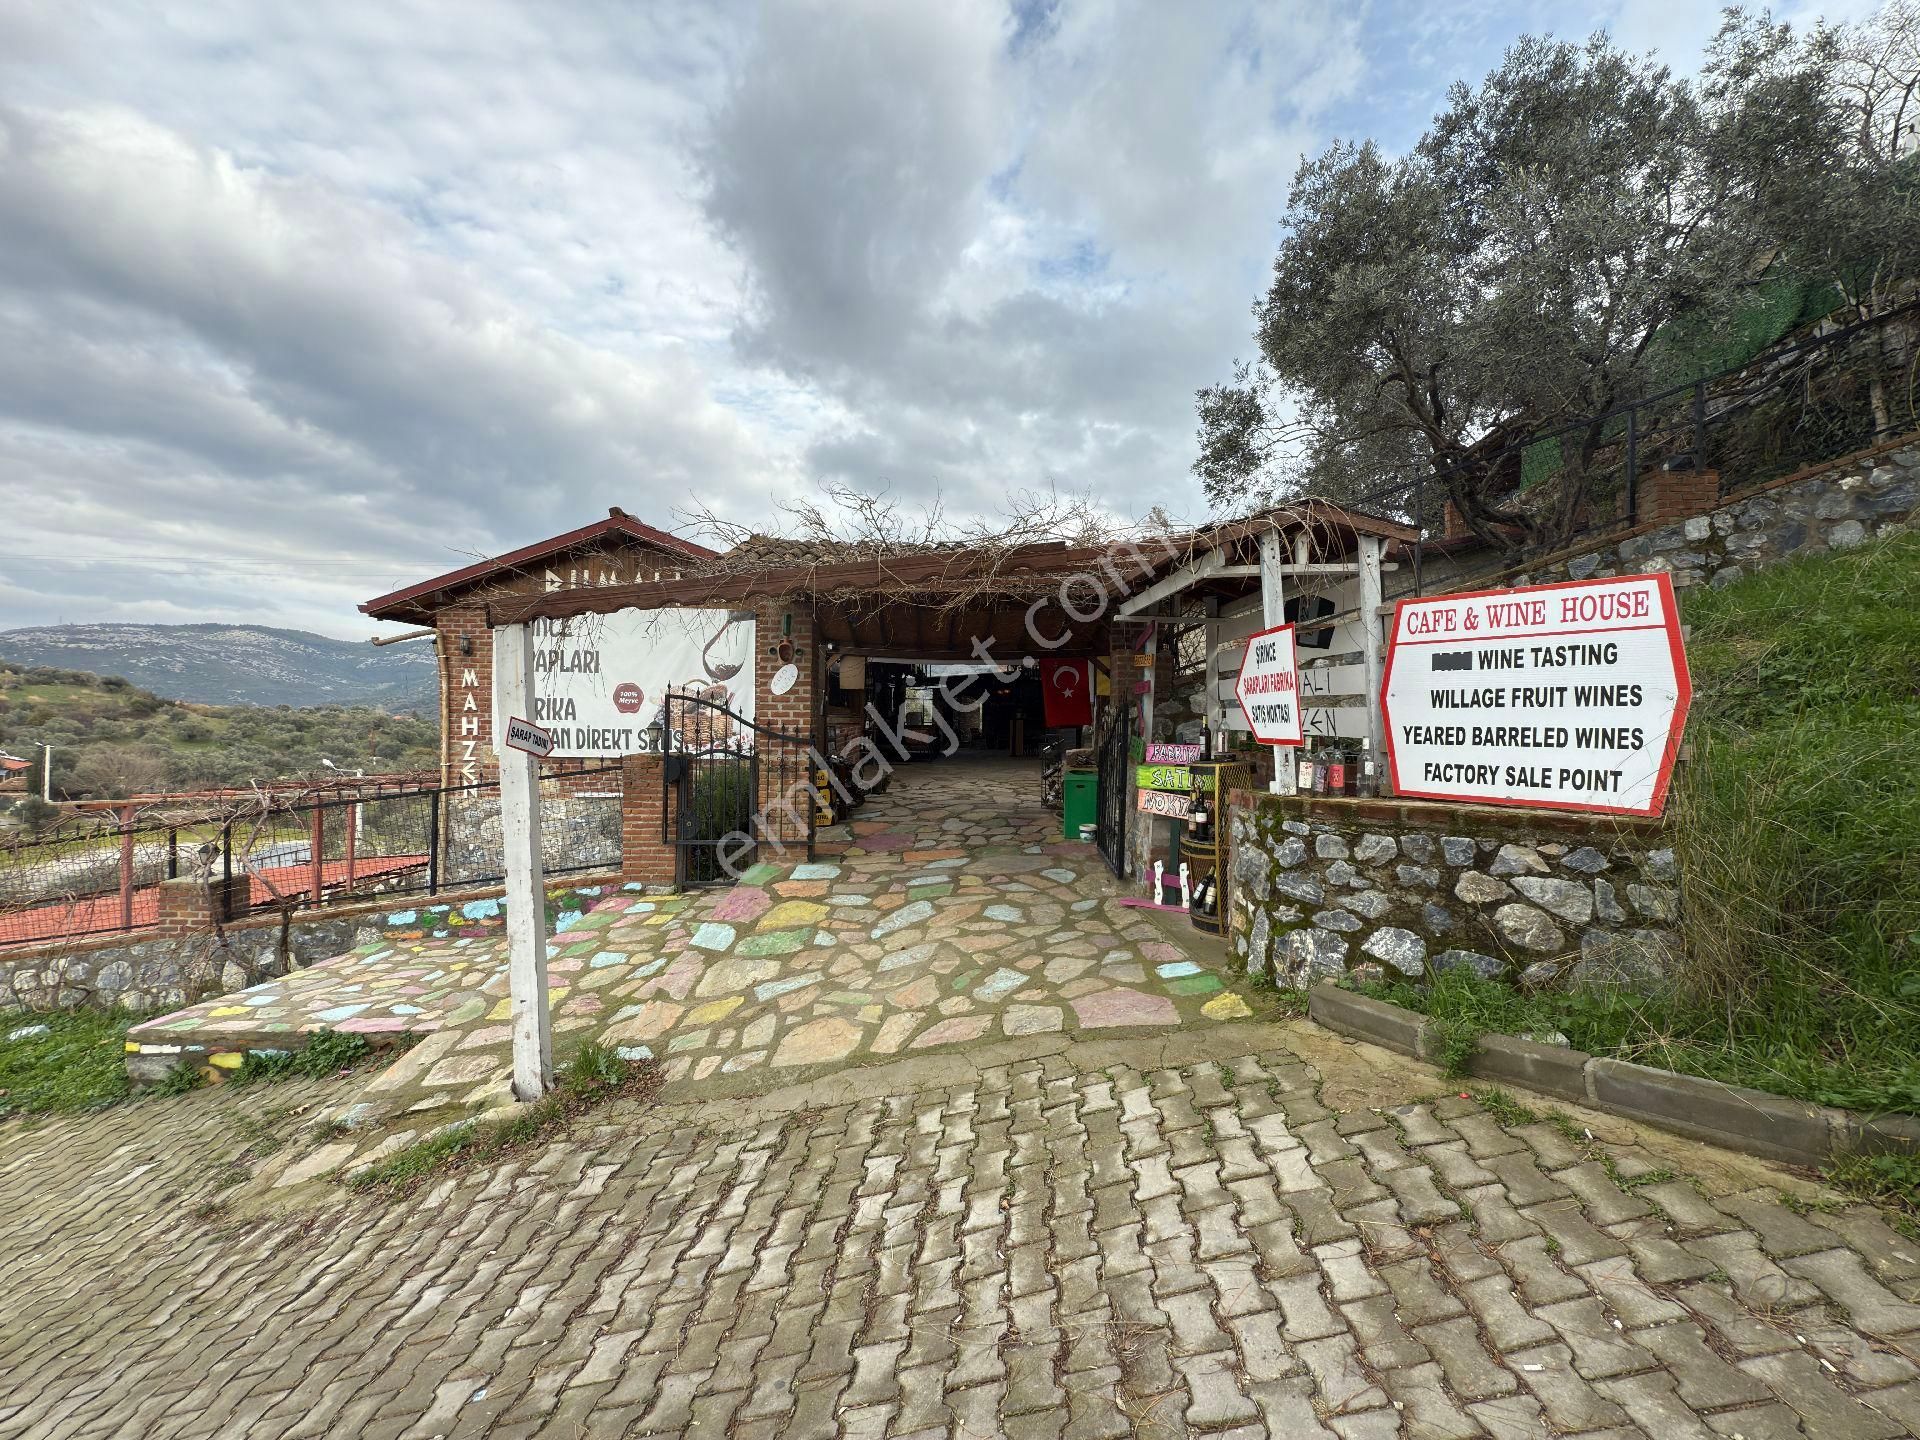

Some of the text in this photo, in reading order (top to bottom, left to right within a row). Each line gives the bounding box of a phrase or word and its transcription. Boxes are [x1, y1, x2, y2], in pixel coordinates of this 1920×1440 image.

[1407, 590, 1649, 635] CAFE & WINE HOUSE
[533, 649, 600, 673] APLARI
[1478, 649, 1524, 670] WINE
[1532, 643, 1618, 667] TASTING
[535, 694, 577, 721] RİKA
[1430, 685, 1643, 709] WILLAGE FRUIT WINES
[1300, 708, 1337, 737] ZEN
[576, 725, 632, 750] DİREKT
[1403, 726, 1644, 750] YEARED BARRELED WINES
[1424, 763, 1622, 792] FACTORY SALE POINT
